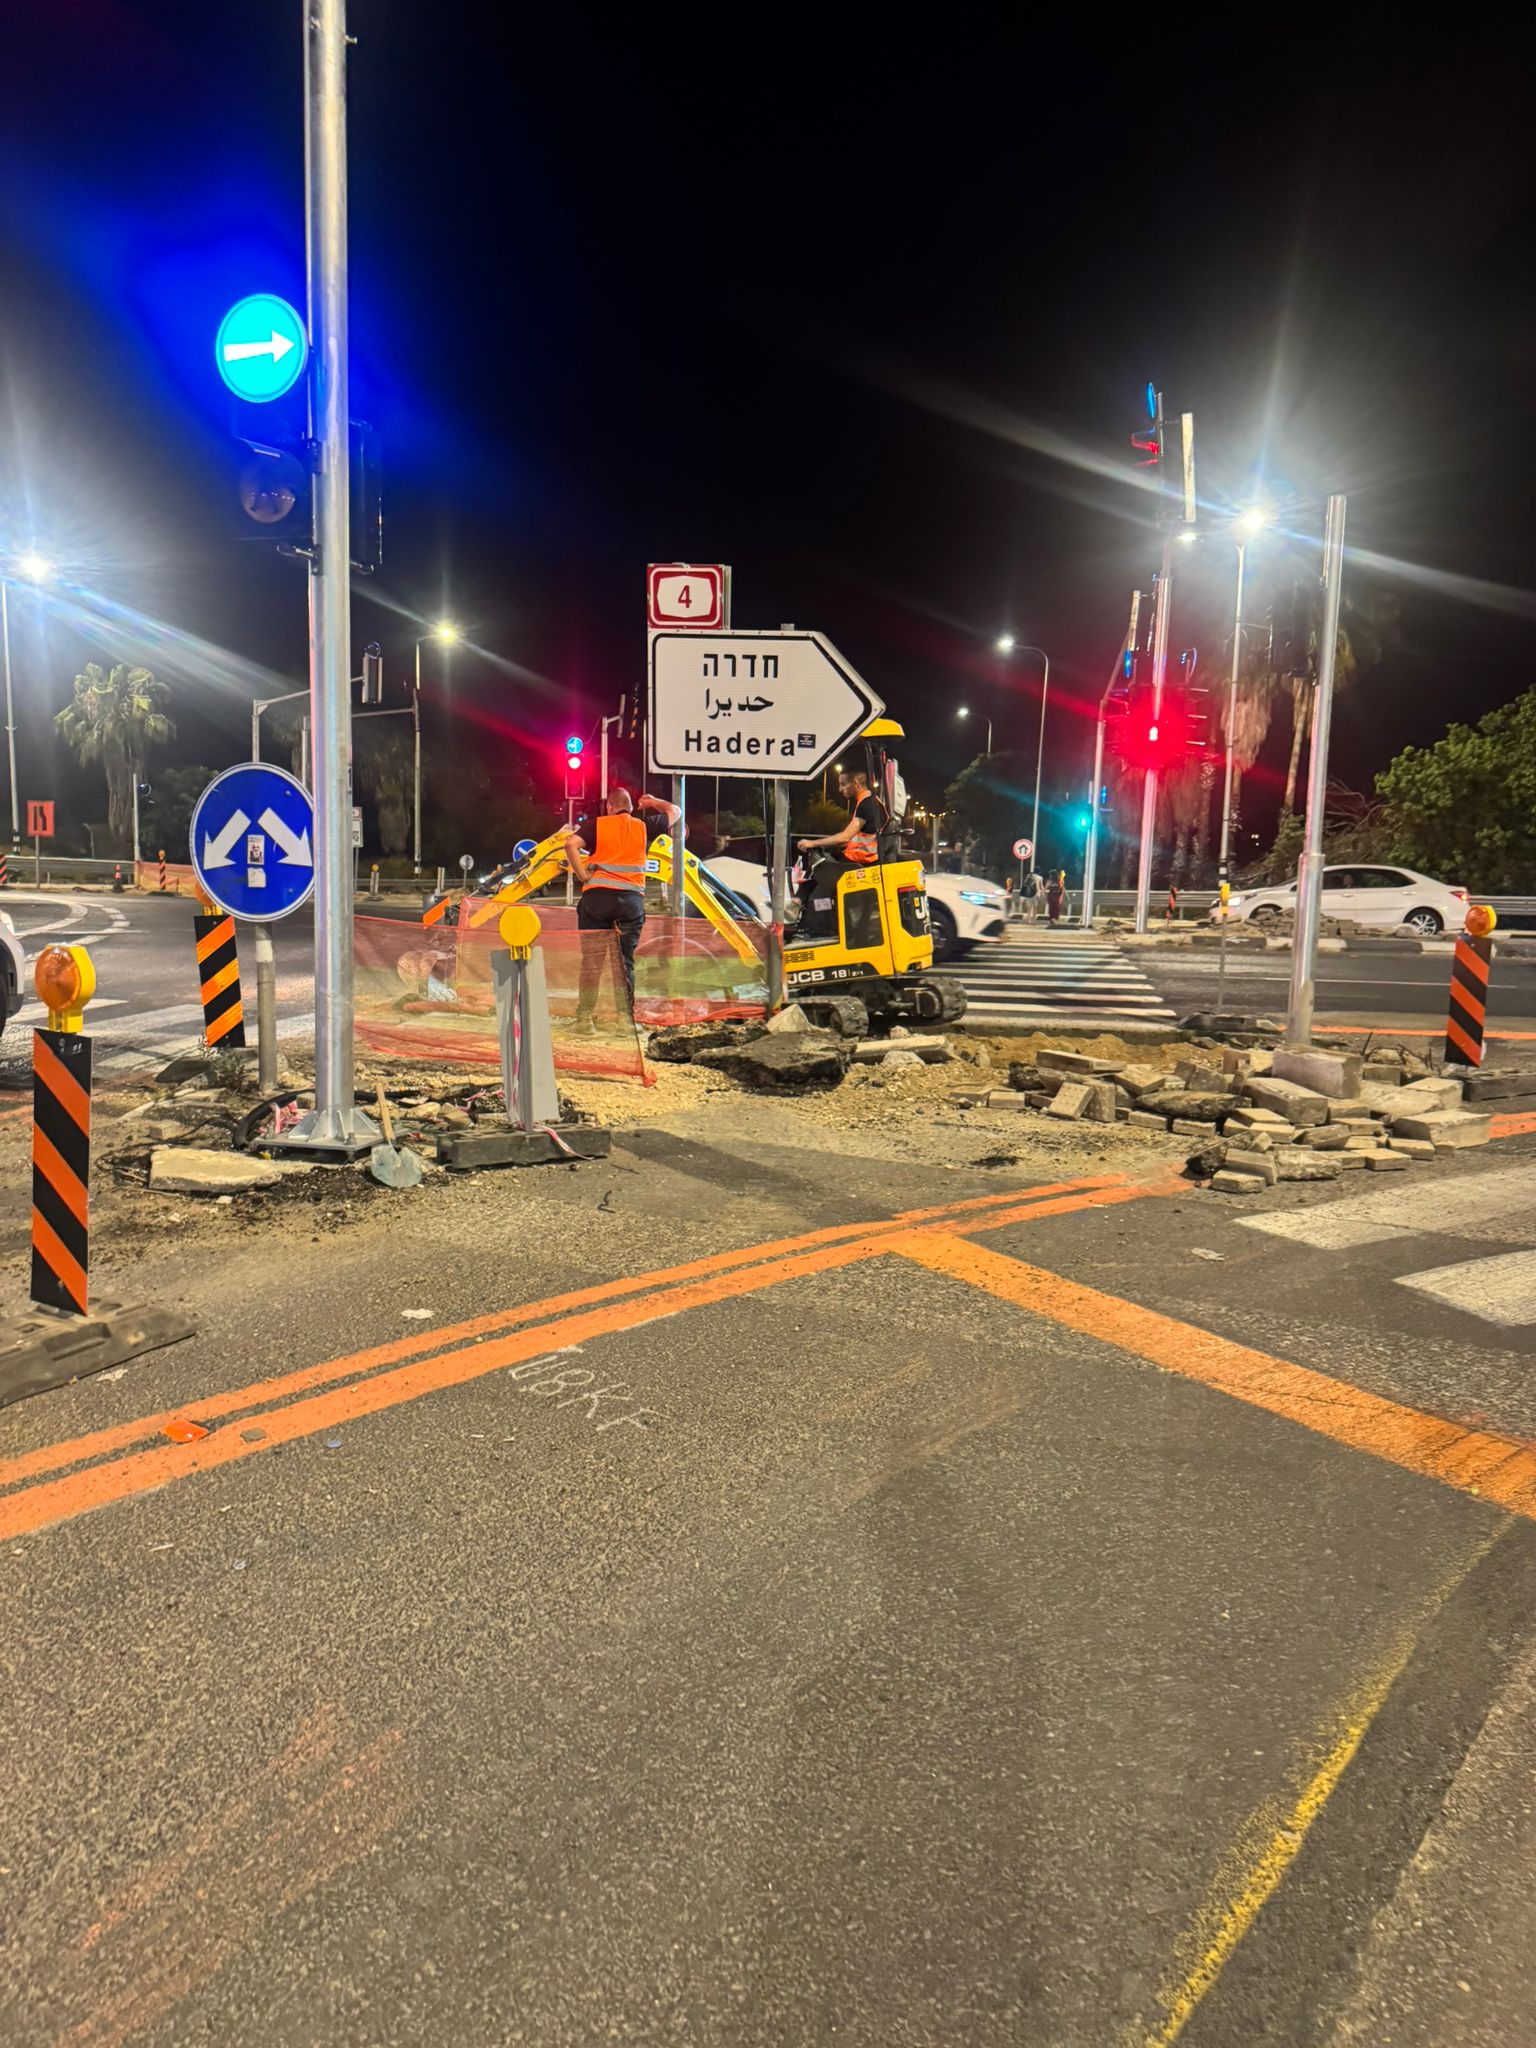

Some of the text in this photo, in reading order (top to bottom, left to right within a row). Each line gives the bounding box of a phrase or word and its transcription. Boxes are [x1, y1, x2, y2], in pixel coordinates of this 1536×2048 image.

[678, 584, 692, 609] 4
[703, 653, 778, 678] חדרה
[705, 688, 774, 719] حديرا
[684, 729, 795, 756] Hadera
[788, 970, 825, 985] JCB
[831, 969, 847, 979] 18
